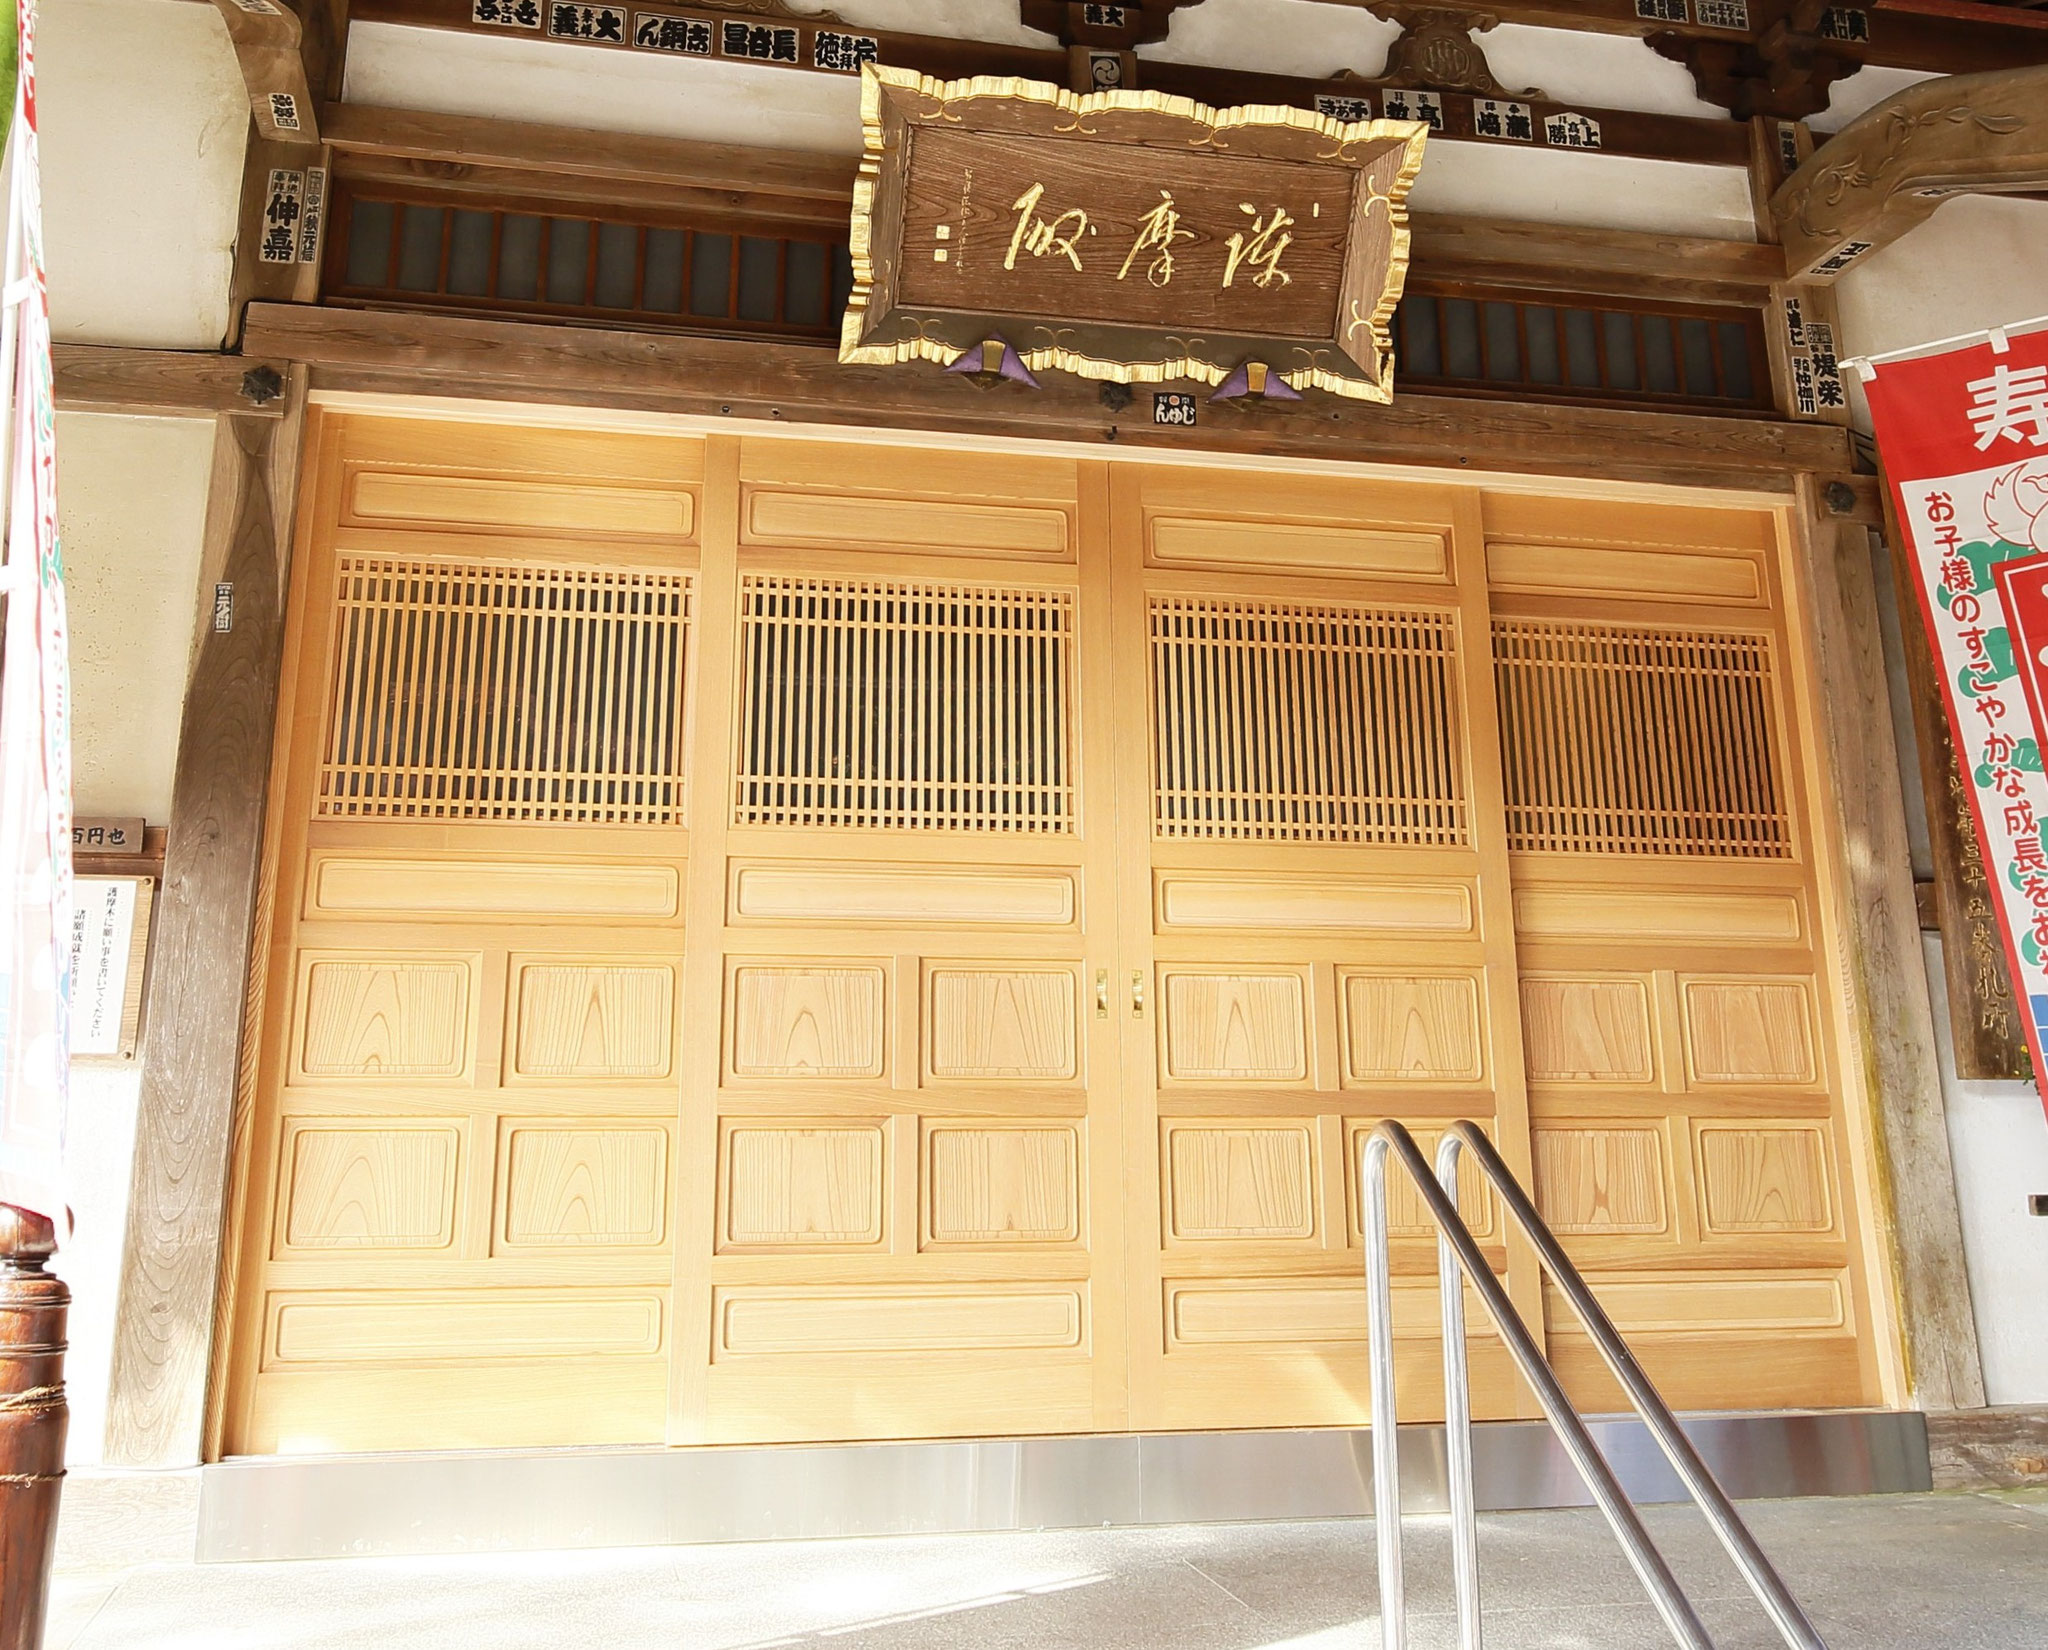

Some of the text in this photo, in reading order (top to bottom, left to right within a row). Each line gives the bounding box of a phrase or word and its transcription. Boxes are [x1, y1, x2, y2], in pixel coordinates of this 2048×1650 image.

[1925, 491, 2048, 976] お子様のすこやかな成長をお
